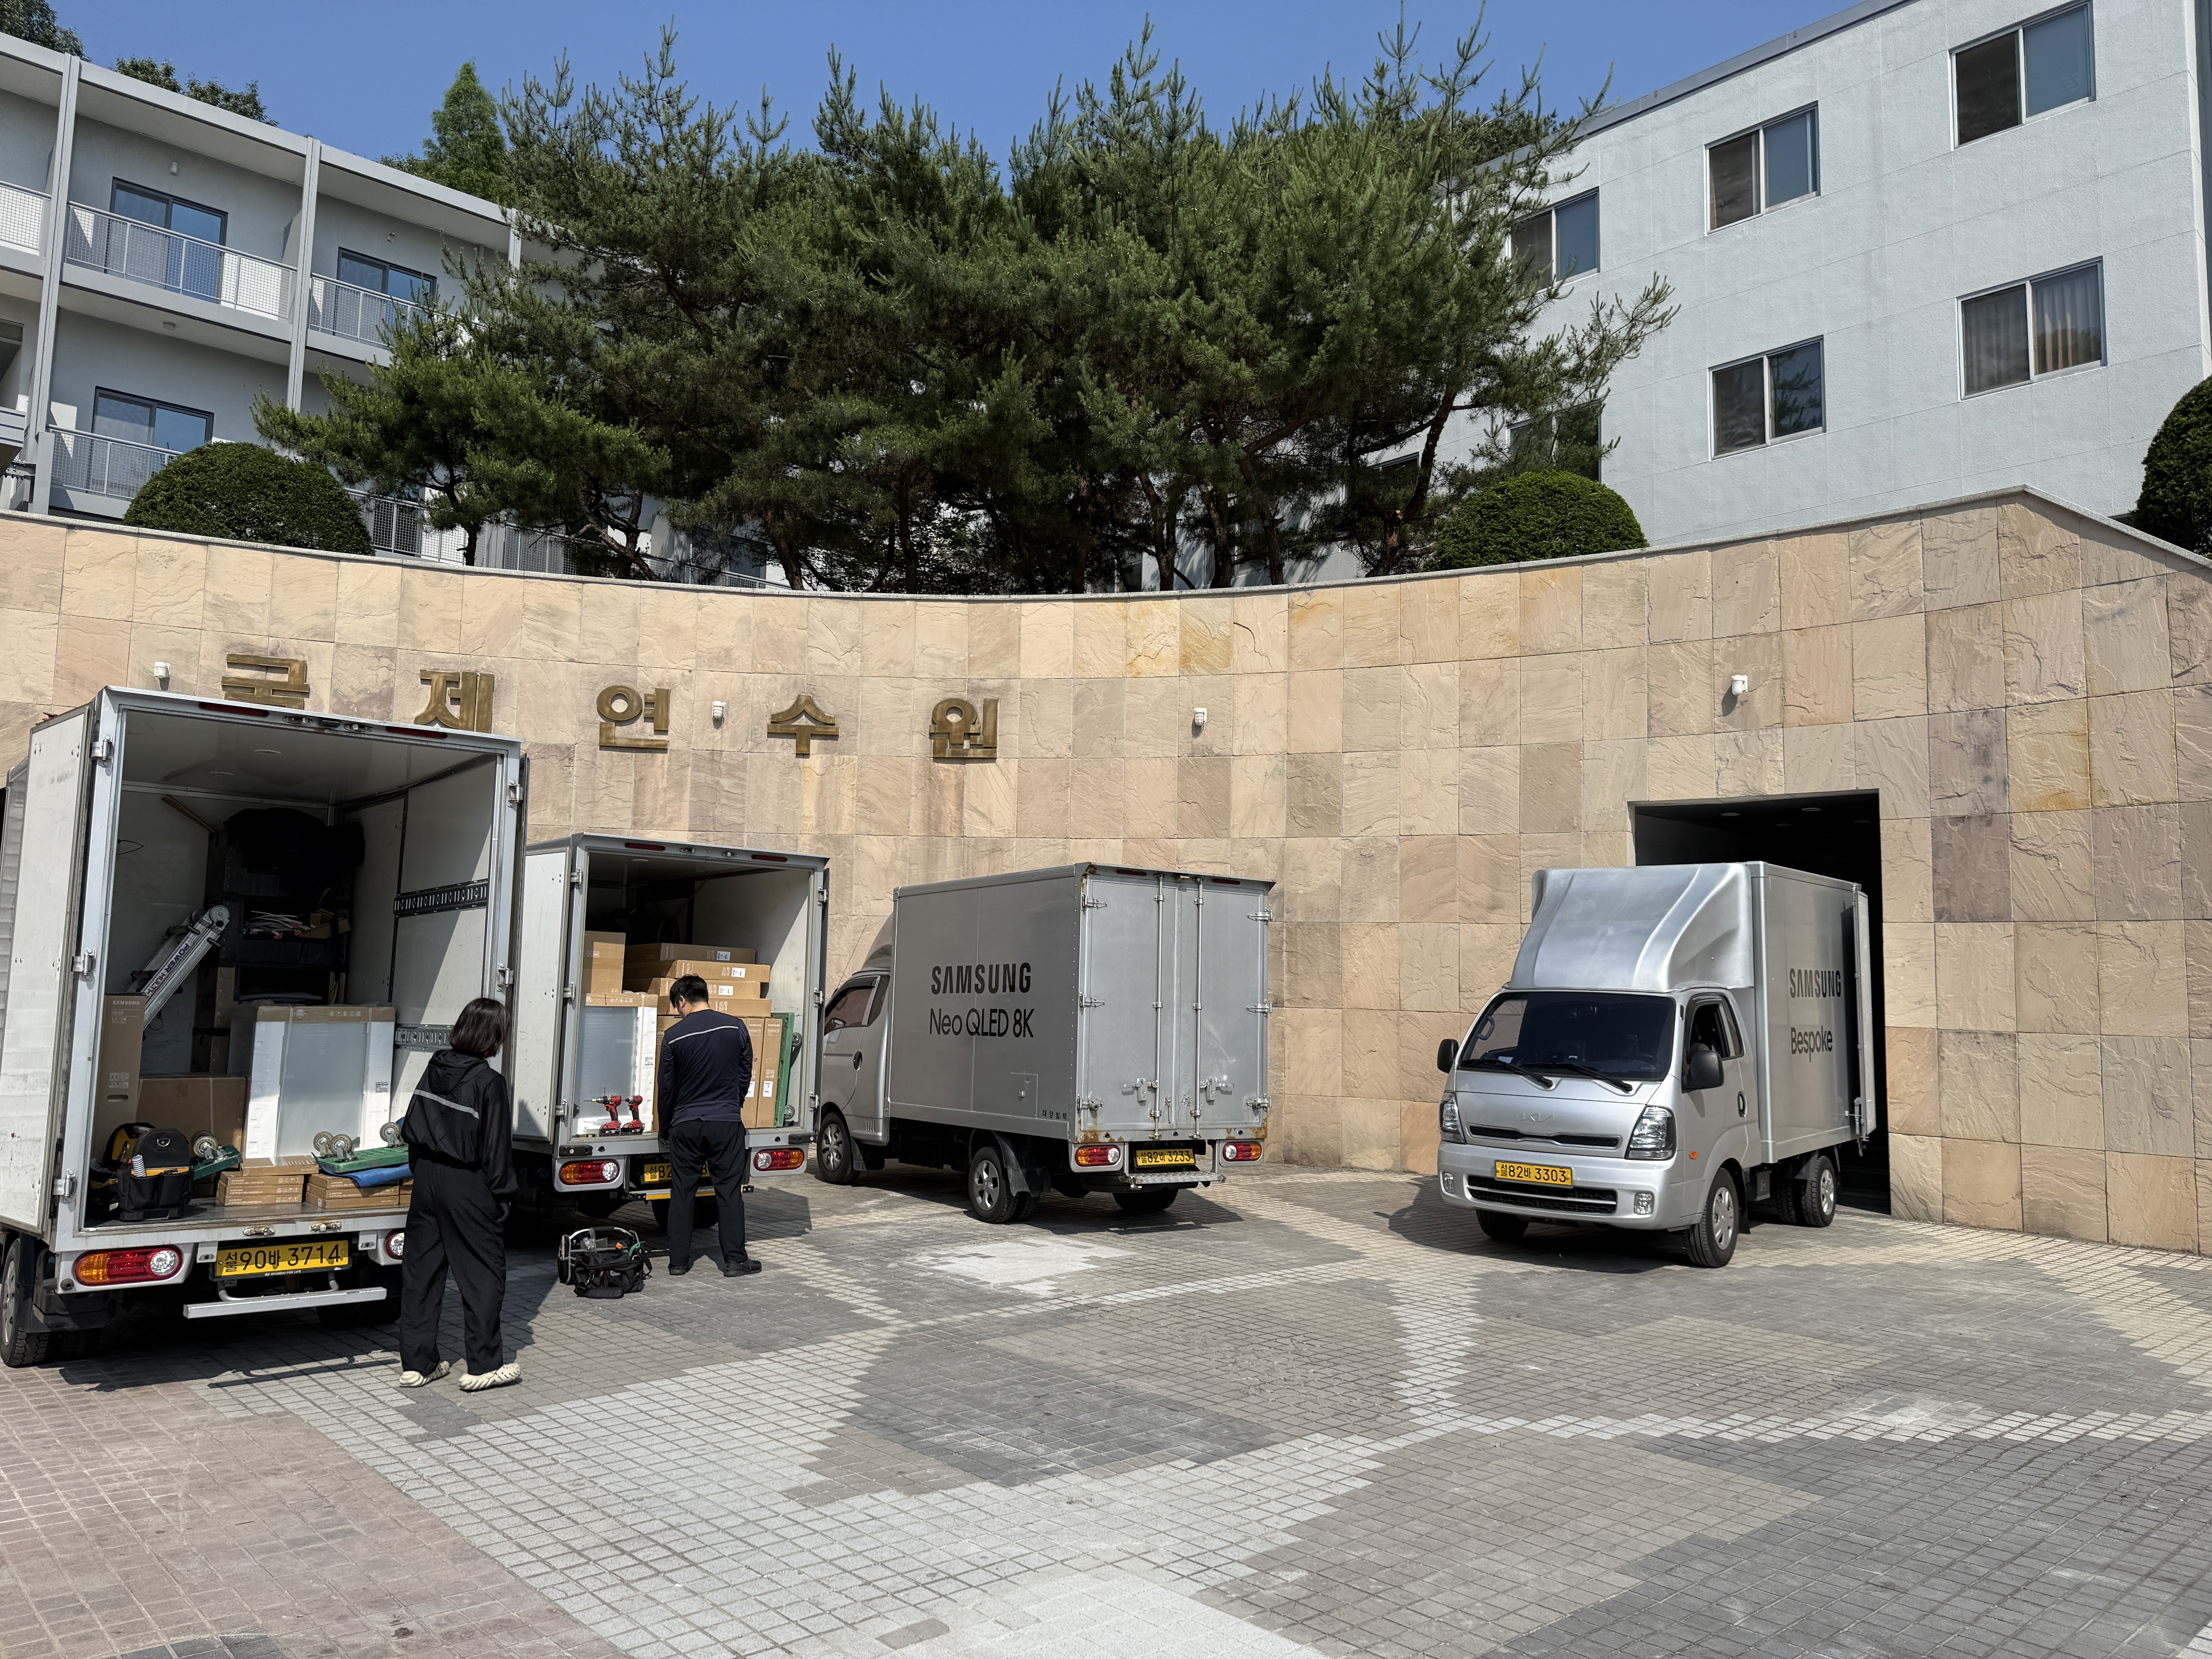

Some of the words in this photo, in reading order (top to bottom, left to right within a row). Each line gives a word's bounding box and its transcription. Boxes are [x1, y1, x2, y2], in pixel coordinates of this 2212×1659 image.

[165, 943, 190, 973] POWER
[931, 962, 1031, 995] SAMSUNG
[1790, 968, 1841, 998] SAMSUNG
[929, 1008, 963, 1036] Neo
[966, 1008, 1009, 1037] QLED
[1012, 1008, 1035, 1038] 8K
[1791, 1025, 1832, 1063] Bespoke
[1167, 1151, 1190, 1162] 3233
[1535, 1168, 1566, 1182] 3303
[287, 1244, 341, 1266] 3714
